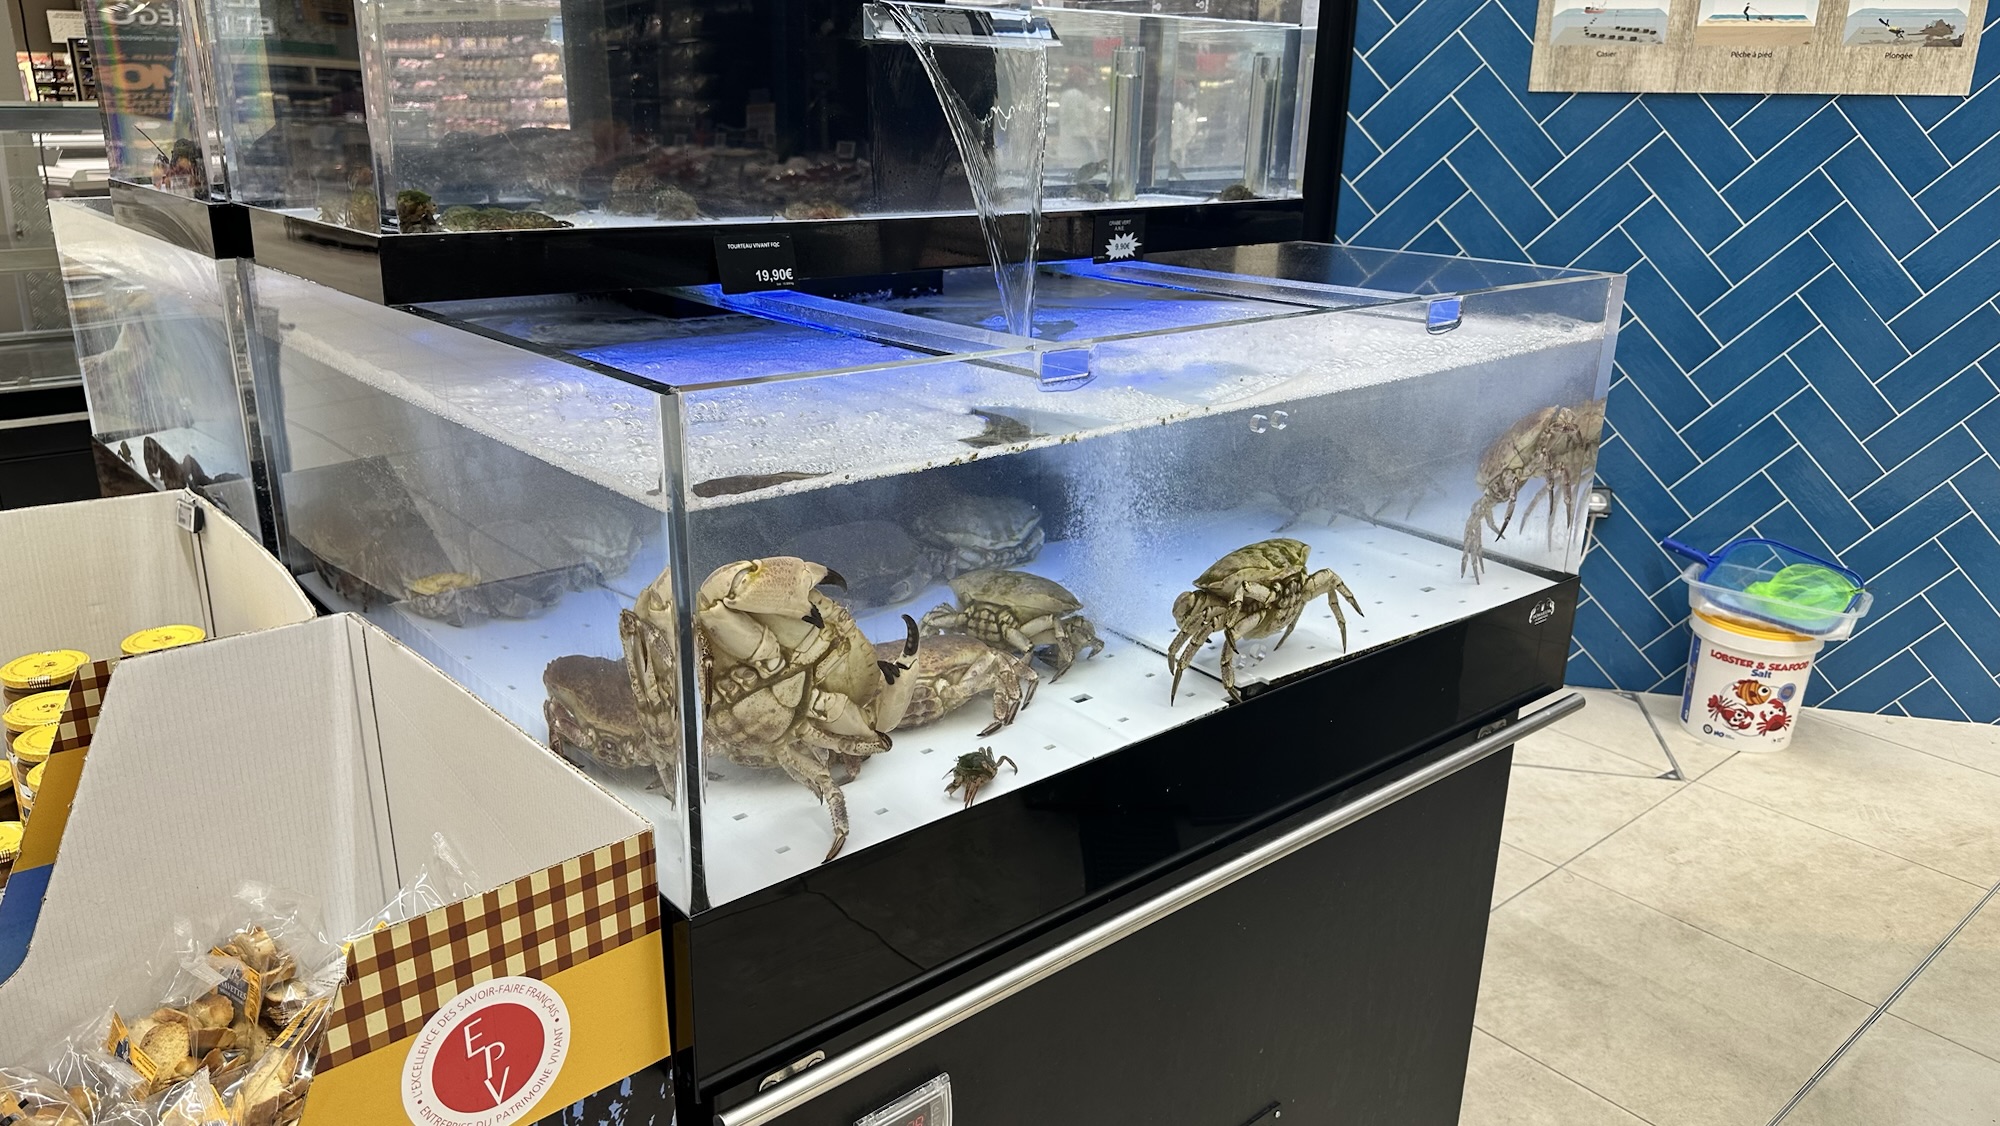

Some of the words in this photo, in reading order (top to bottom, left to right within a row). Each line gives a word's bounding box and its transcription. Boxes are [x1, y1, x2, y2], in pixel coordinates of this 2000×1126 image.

[1596, 50, 1617, 58] Casier
[1758, 51, 1773, 59] pied
[1884, 51, 1913, 60] Plongée
[755, 268, 793, 283] 19,90€
[1710, 649, 1754, 668] LOBSTER
[1756, 662, 1766, 670] &
[1768, 660, 1809, 671] SEAFOOD
[1751, 669, 1772, 678] Salt
[411, 1027, 440, 1099] L'EXCELLENCE
[437, 1008, 457, 1028] DES
[457, 983, 526, 1012] SAVOIR-FAIRE
[525, 986, 560, 1018] FRANÇAIS
[496, 1068, 553, 1123] PATRIMOINE
[548, 1027, 563, 1066] VIVANT
